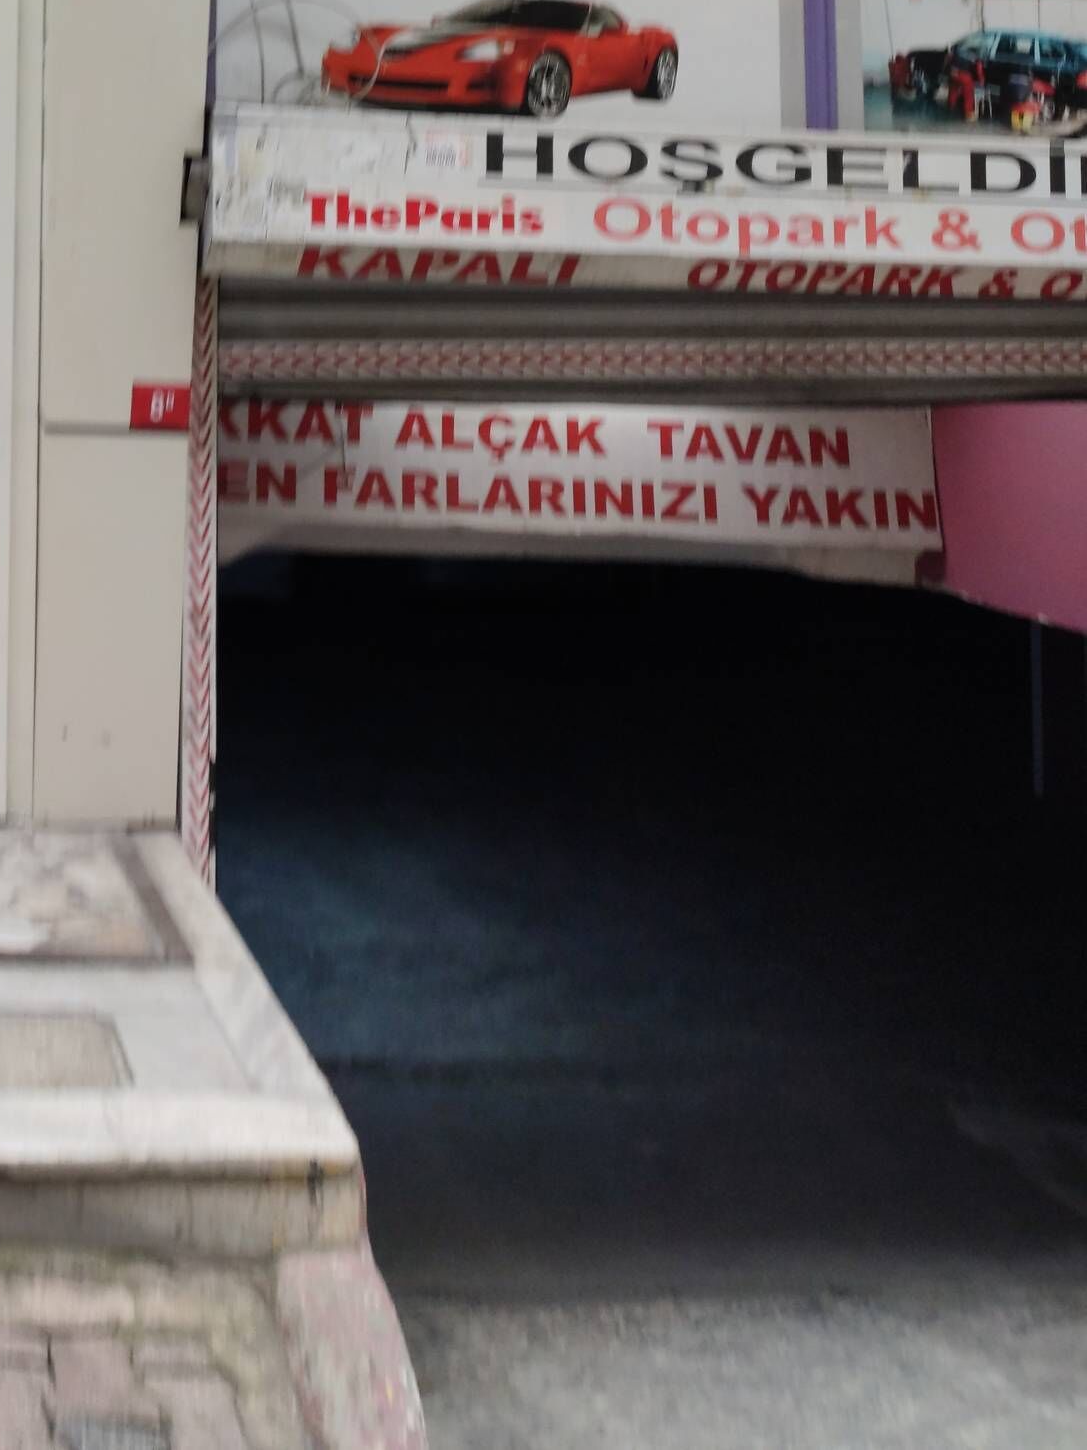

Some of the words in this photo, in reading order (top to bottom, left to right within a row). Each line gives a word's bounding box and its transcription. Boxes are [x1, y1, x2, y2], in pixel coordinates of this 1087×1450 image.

[305, 185, 546, 236] TheParis
[593, 196, 904, 259] Otopark
[931, 206, 981, 254] &
[296, 242, 581, 288] KAPALI
[687, 257, 964, 300] OTOPARK
[976, 264, 1019, 300] &
[393, 407, 608, 464] ALÇAK
[646, 417, 850, 470] TAVAN
[741, 482, 939, 530] YAKIN
